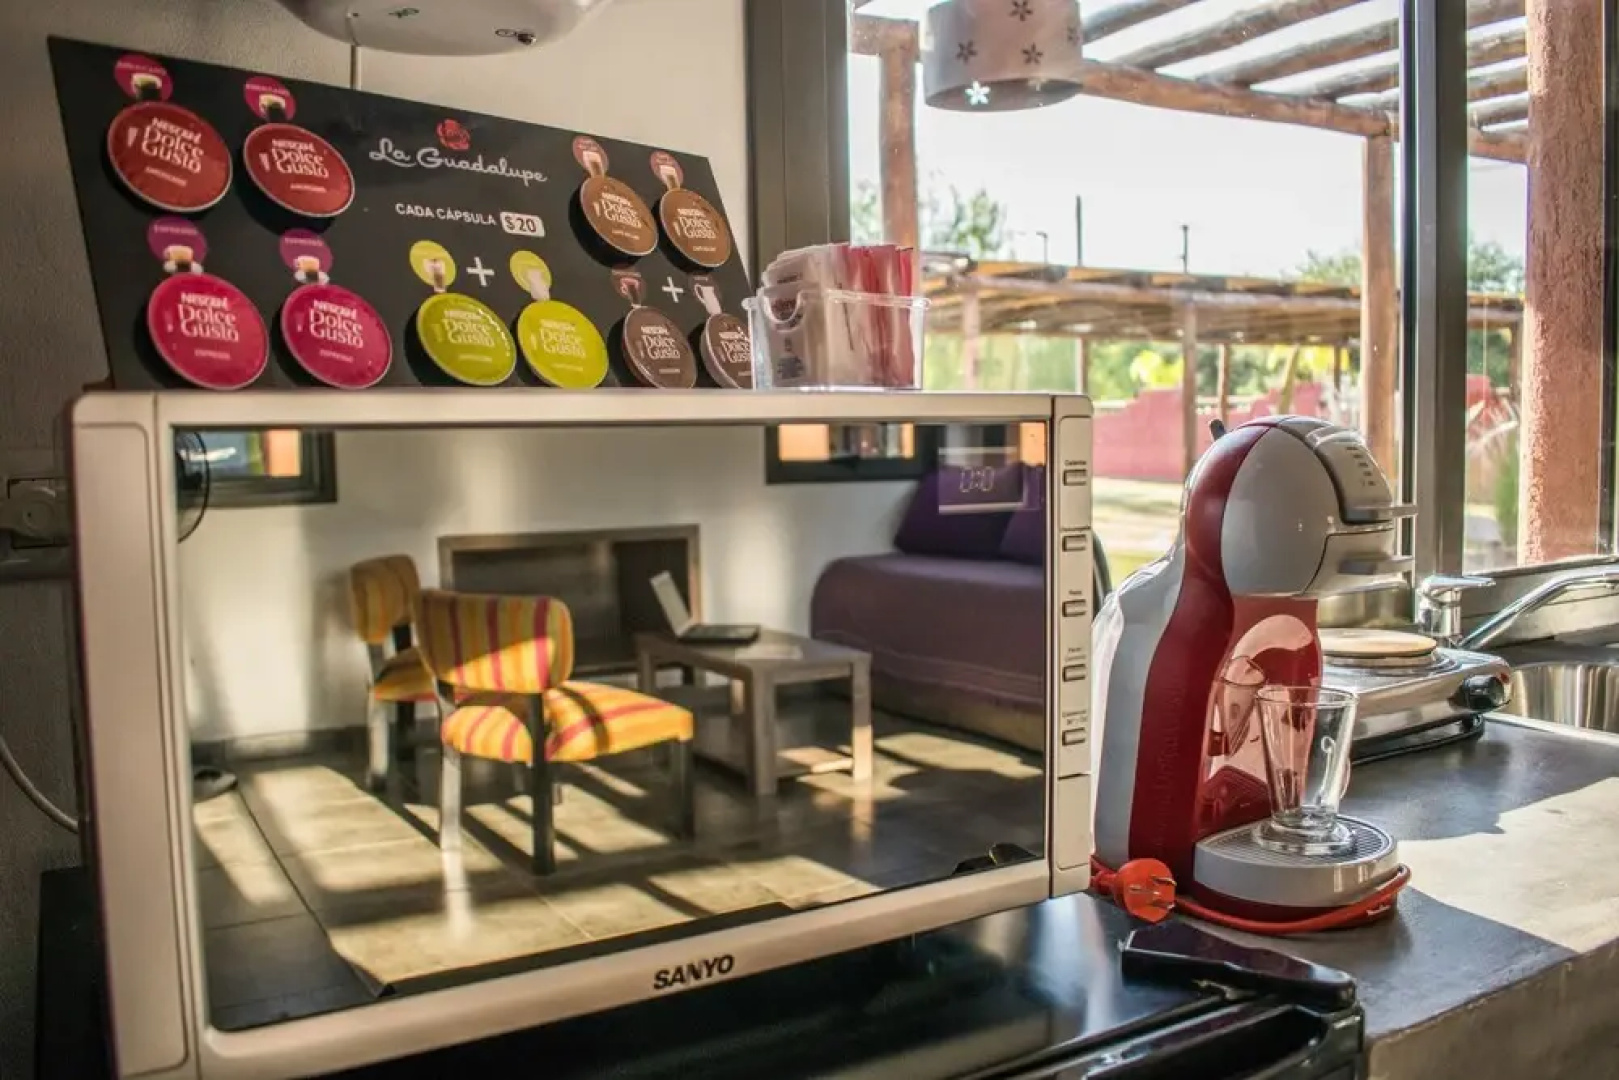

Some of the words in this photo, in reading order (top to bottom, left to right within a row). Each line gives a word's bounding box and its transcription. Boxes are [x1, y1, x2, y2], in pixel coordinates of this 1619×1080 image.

[144, 125, 204, 158] Dolce
[142, 141, 201, 173] Gusto
[271, 148, 324, 165] Dolce
[369, 137, 416, 167] La
[416, 147, 548, 188] Guadalupe
[275, 160, 329, 178] Gusto
[395, 203, 434, 219] CADA
[600, 198, 638, 218] Dolce
[604, 209, 642, 229] Gusto
[678, 216, 712, 230] Dolce
[683, 224, 717, 239] Gusto
[178, 303, 236, 326] Dolce
[310, 308, 362, 334] Dolce
[180, 320, 239, 342] Gusto
[310, 323, 363, 349] Gusto
[442, 318, 491, 336] Dolce
[641, 334, 676, 347] Dolce
[647, 345, 681, 359] Gusto
[727, 350, 750, 363] Gust
[653, 954, 735, 990] SANYO
